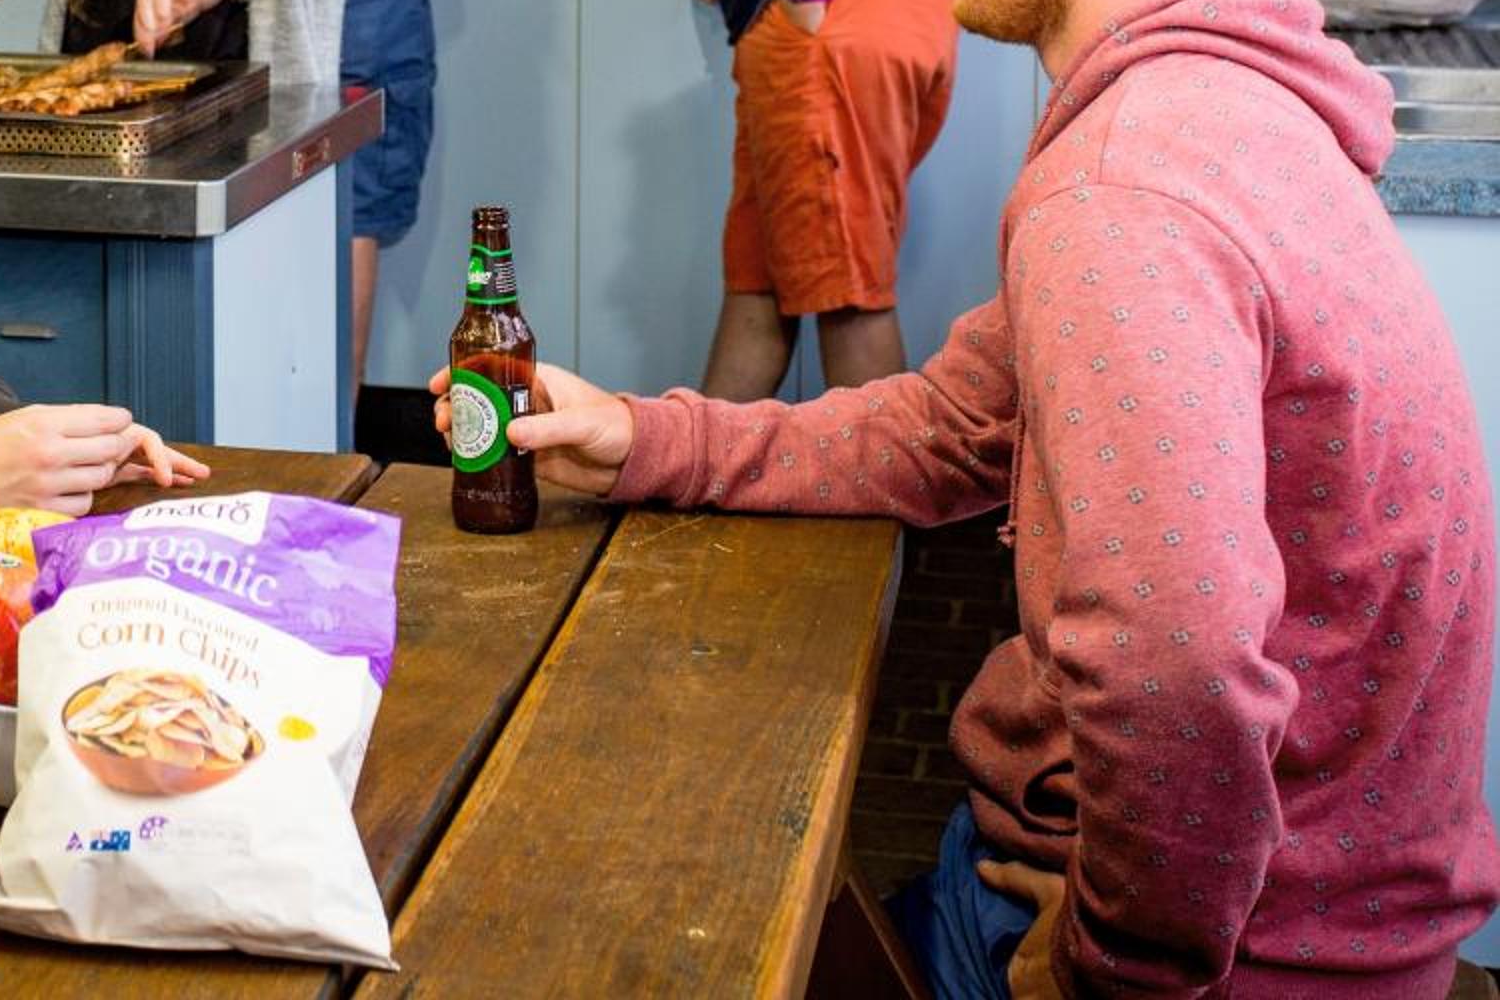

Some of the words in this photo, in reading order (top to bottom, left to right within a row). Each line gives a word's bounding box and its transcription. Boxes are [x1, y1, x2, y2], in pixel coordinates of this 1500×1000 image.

[85, 535, 277, 607] organic
[77, 621, 165, 650] Corn
[178, 627, 260, 690] Chips
